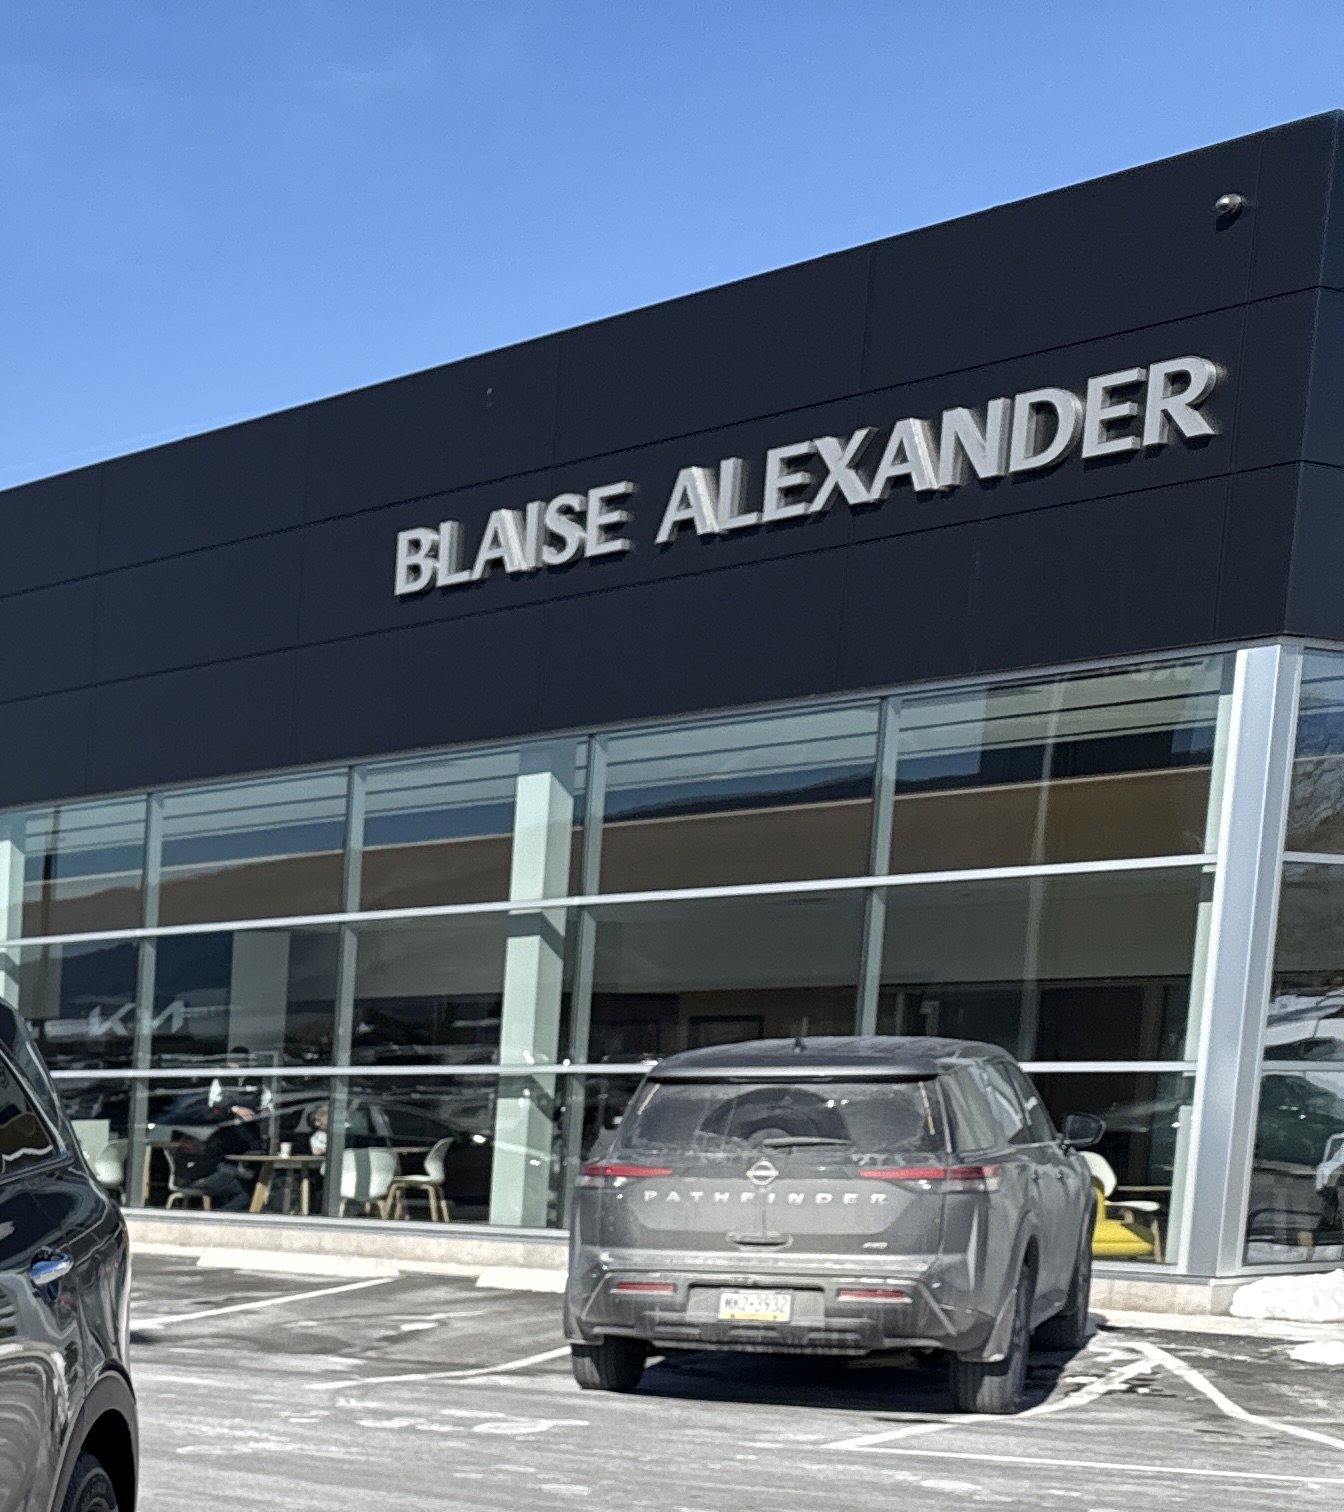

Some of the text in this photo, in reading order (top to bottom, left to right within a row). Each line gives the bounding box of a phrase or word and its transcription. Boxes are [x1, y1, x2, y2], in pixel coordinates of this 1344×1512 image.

[394, 355, 1221, 596] BLAISE ALEXANDER
[89, 999, 184, 1035] KA
[643, 1190, 887, 1205] PATHFINDER
